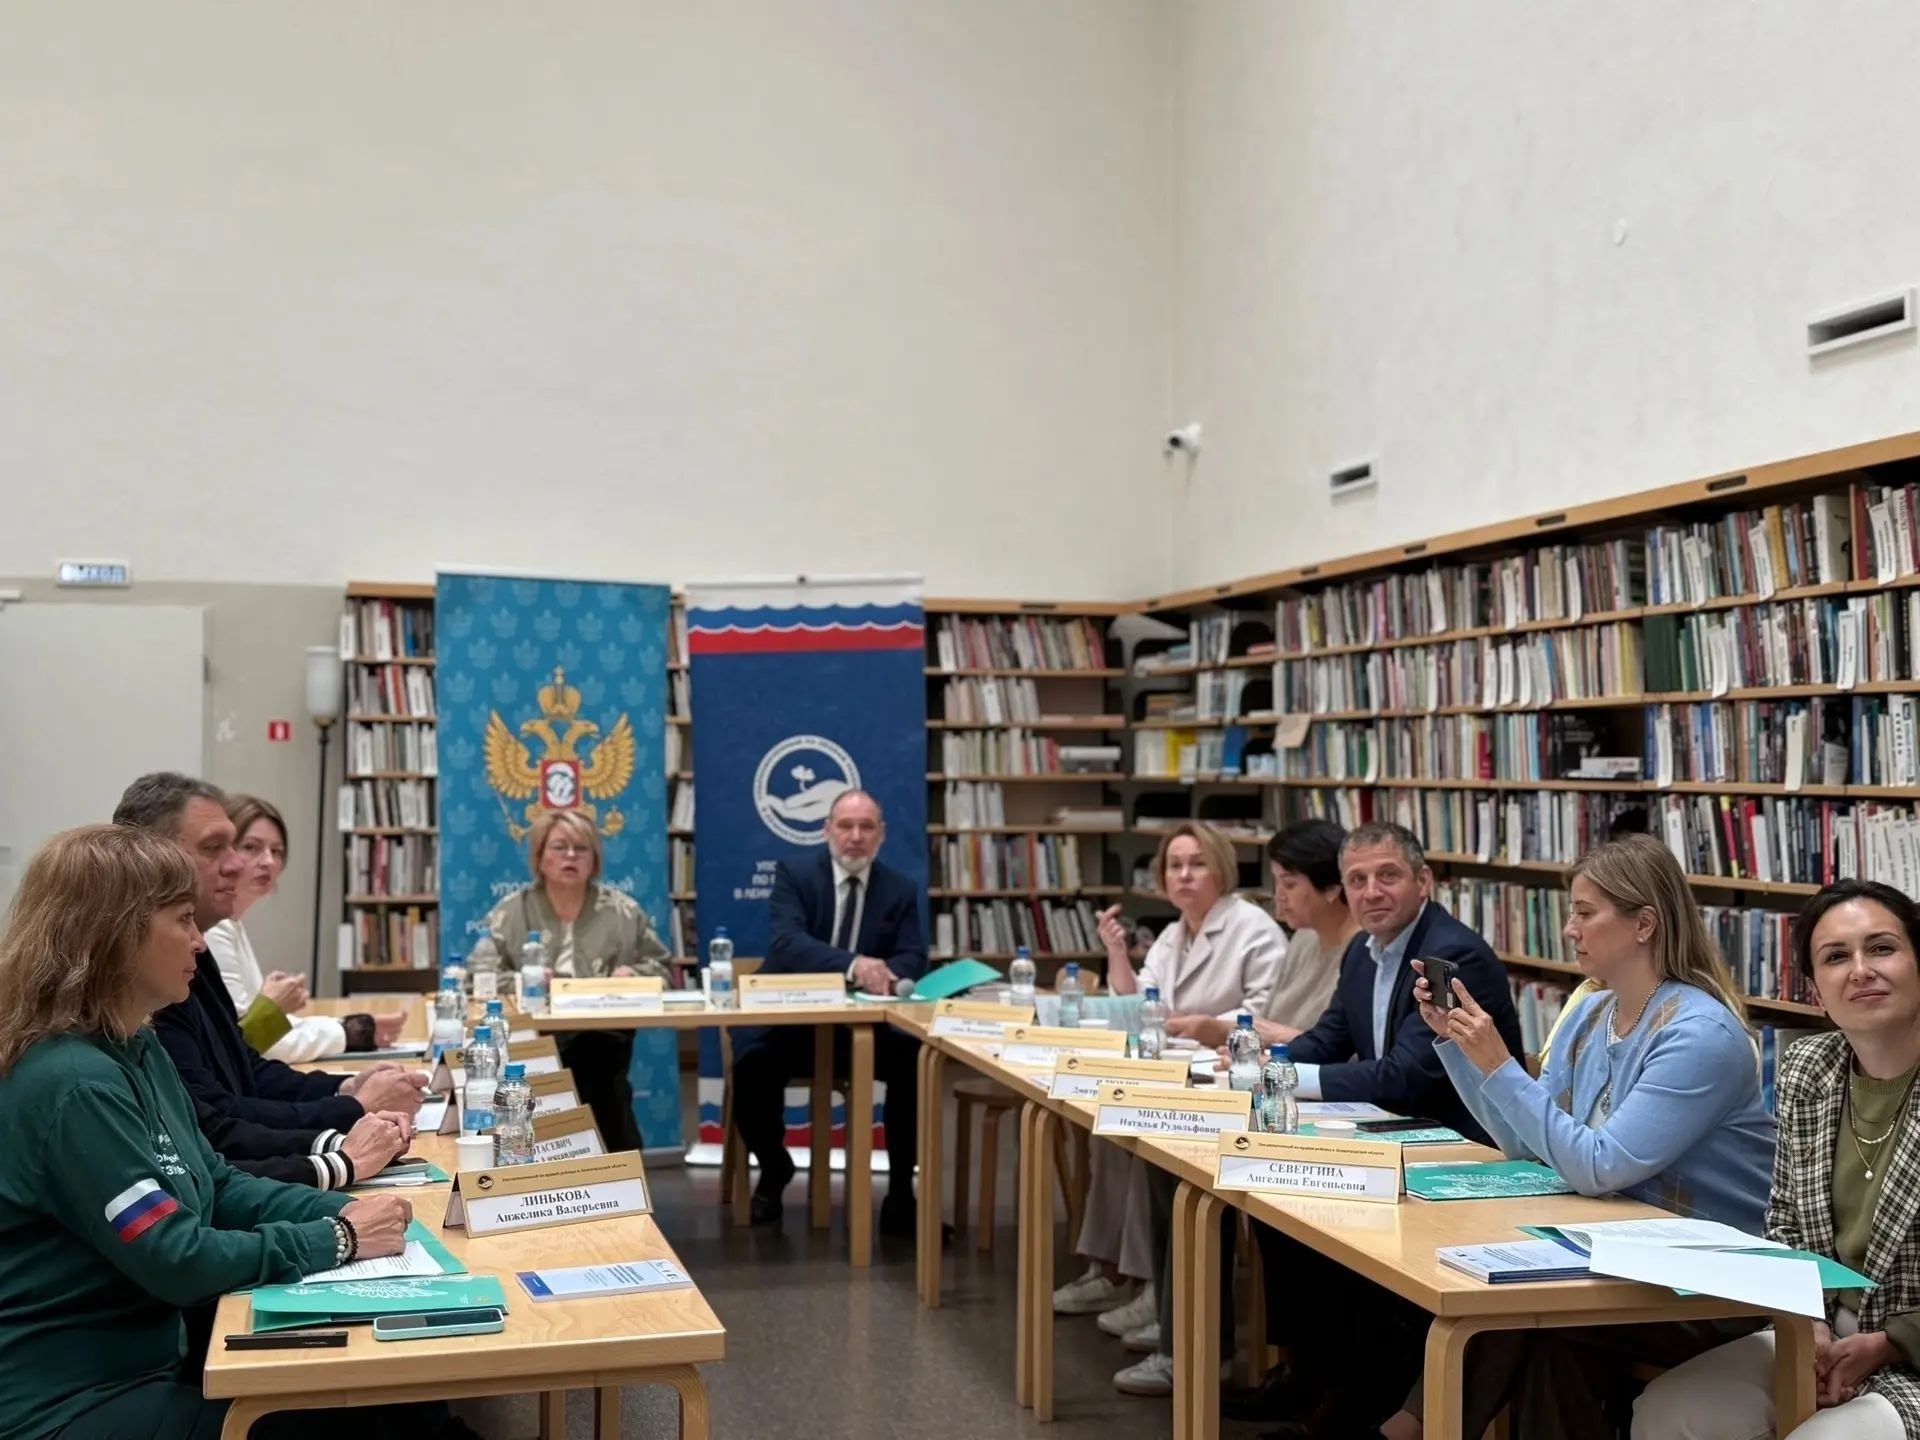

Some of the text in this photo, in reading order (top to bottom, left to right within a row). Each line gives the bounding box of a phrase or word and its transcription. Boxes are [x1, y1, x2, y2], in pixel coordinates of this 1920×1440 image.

[1138, 1108, 1205, 1122] МИХАЙЛОВА
[1119, 1118, 1221, 1134] Наталья Рудольфовна
[1269, 1162, 1344, 1178] СЕВЕРГИНА
[1246, 1173, 1366, 1191] Ангелина Евгеньевна
[520, 1189, 591, 1207] ЛИНЬКОВА
[496, 1199, 620, 1223] Анжелика Валерьевна
